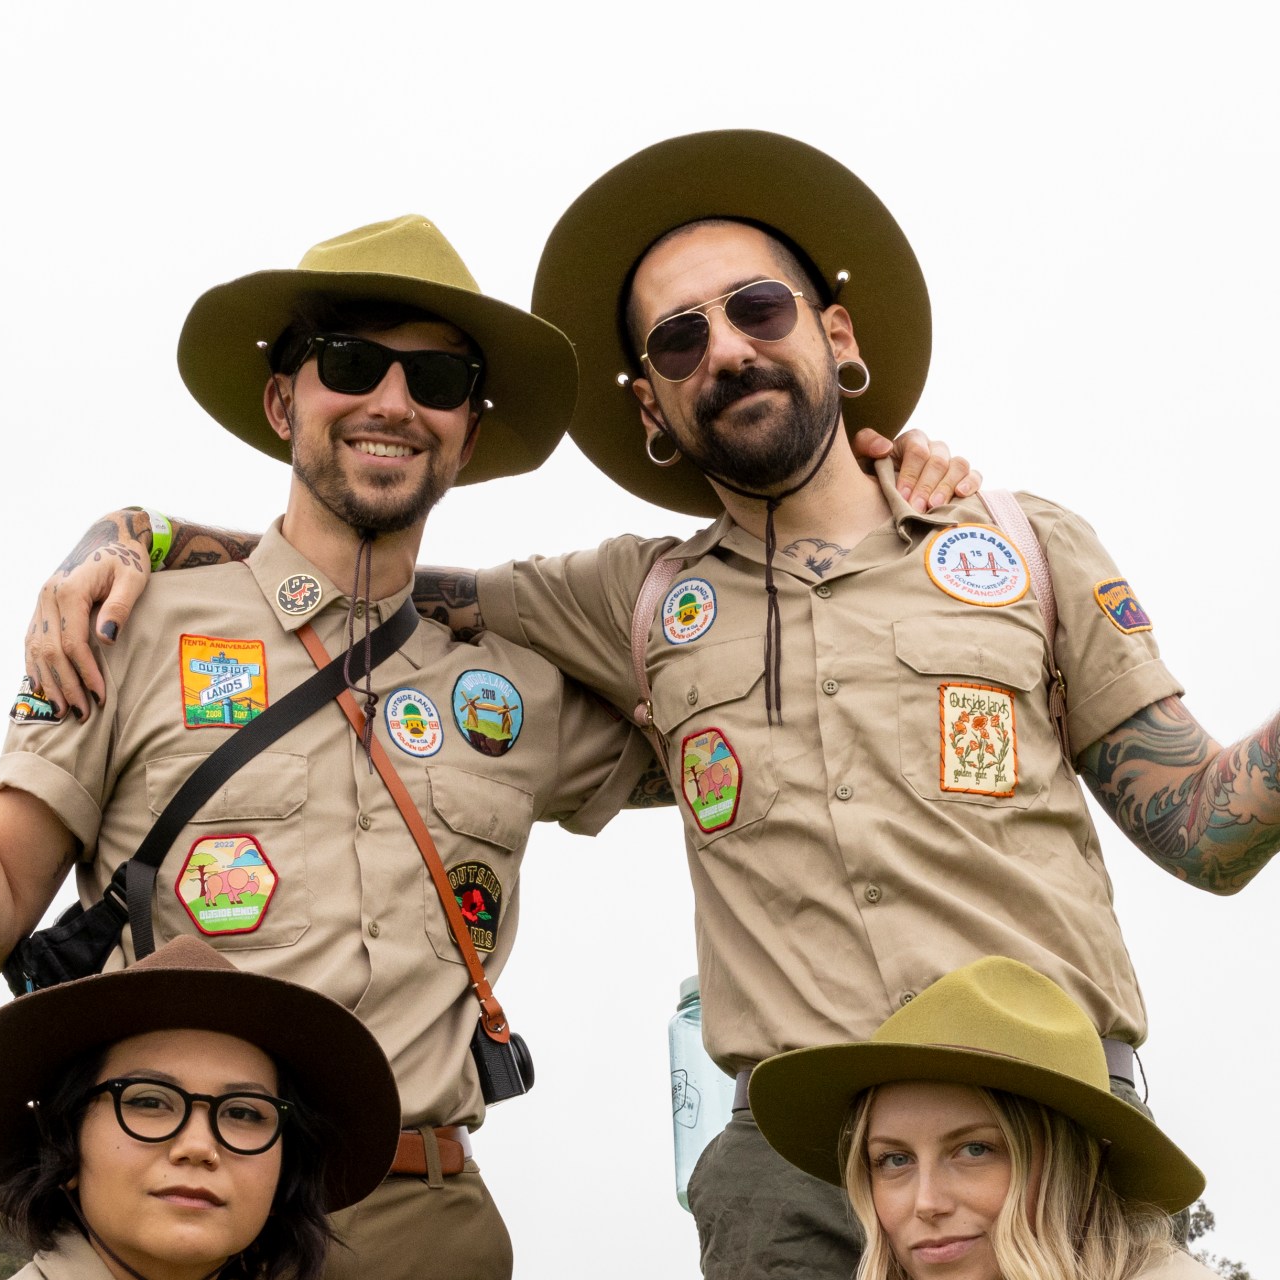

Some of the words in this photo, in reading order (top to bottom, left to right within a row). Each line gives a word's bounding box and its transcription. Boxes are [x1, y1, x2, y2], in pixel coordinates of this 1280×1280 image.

[937, 531, 978, 565] OUTSIDE
[979, 533, 1017, 566] LANDS
[944, 574, 960, 588] SAN
[955, 574, 980, 589] GOLDEN
[997, 576, 1008, 587] PARK
[667, 586, 689, 614] OUTSIDE
[690, 584, 709, 601] LANDS
[670, 626, 685, 639] GOLDEN
[209, 642, 260, 650] ANNIVERSARY
[198, 663, 250, 674] OUTSIDE
[207, 679, 242, 700] LANDS
[462, 673, 489, 691] OUTSIDE
[489, 674, 513, 697] LANDS
[391, 694, 412, 717] OUTSIDE
[413, 695, 434, 718] LANDS
[949, 692, 985, 715] Outside
[396, 731, 417, 751] GOLDEN
[994, 773, 1007, 787] park
[449, 866, 500, 903] OUTSIDE
[470, 926, 493, 948] NDS
